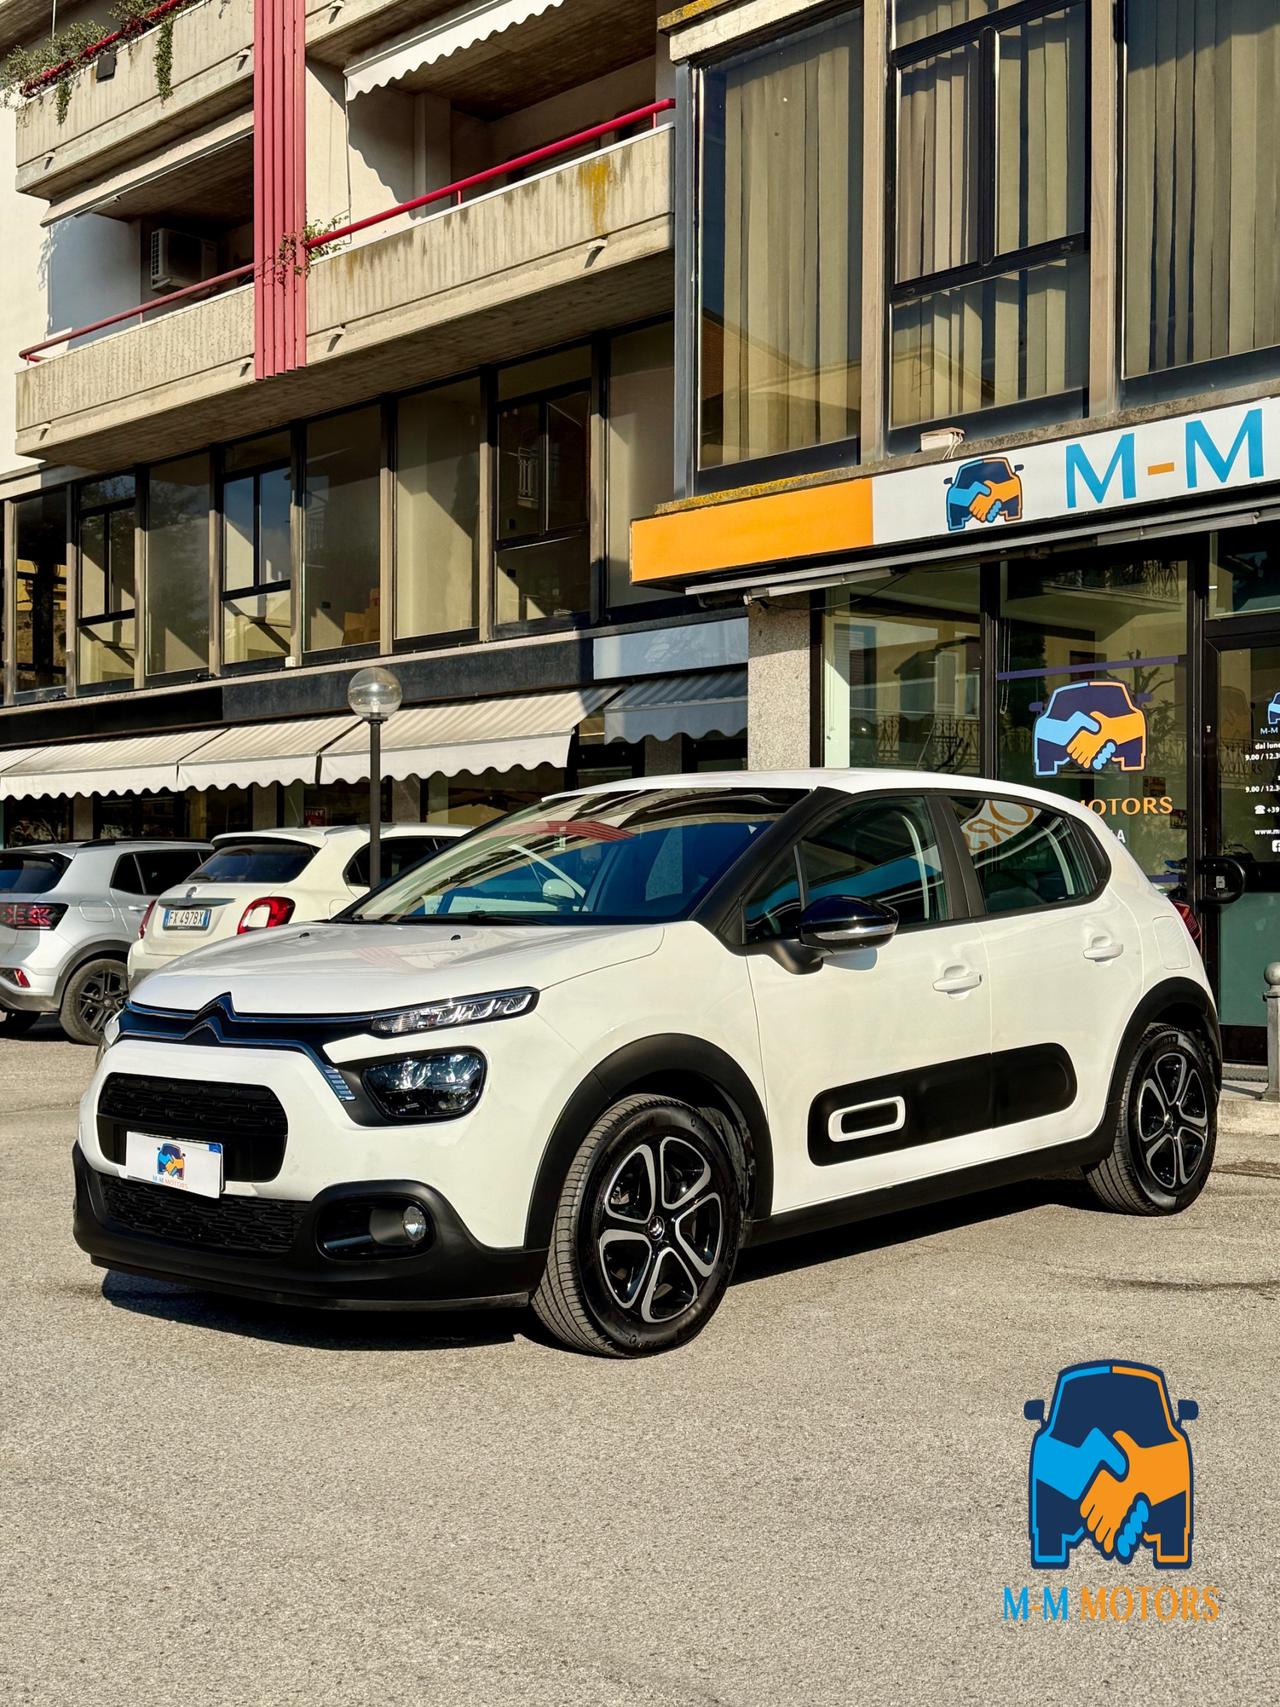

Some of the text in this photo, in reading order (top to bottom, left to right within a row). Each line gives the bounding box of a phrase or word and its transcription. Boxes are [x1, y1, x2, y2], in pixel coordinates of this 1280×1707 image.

[1066, 408, 1264, 508] M-M
[1260, 727, 1278, 735] M-M
[1255, 742, 1266, 750] dal
[1265, 752, 1280, 760] 12.3
[1080, 796, 1174, 816] OTORS
